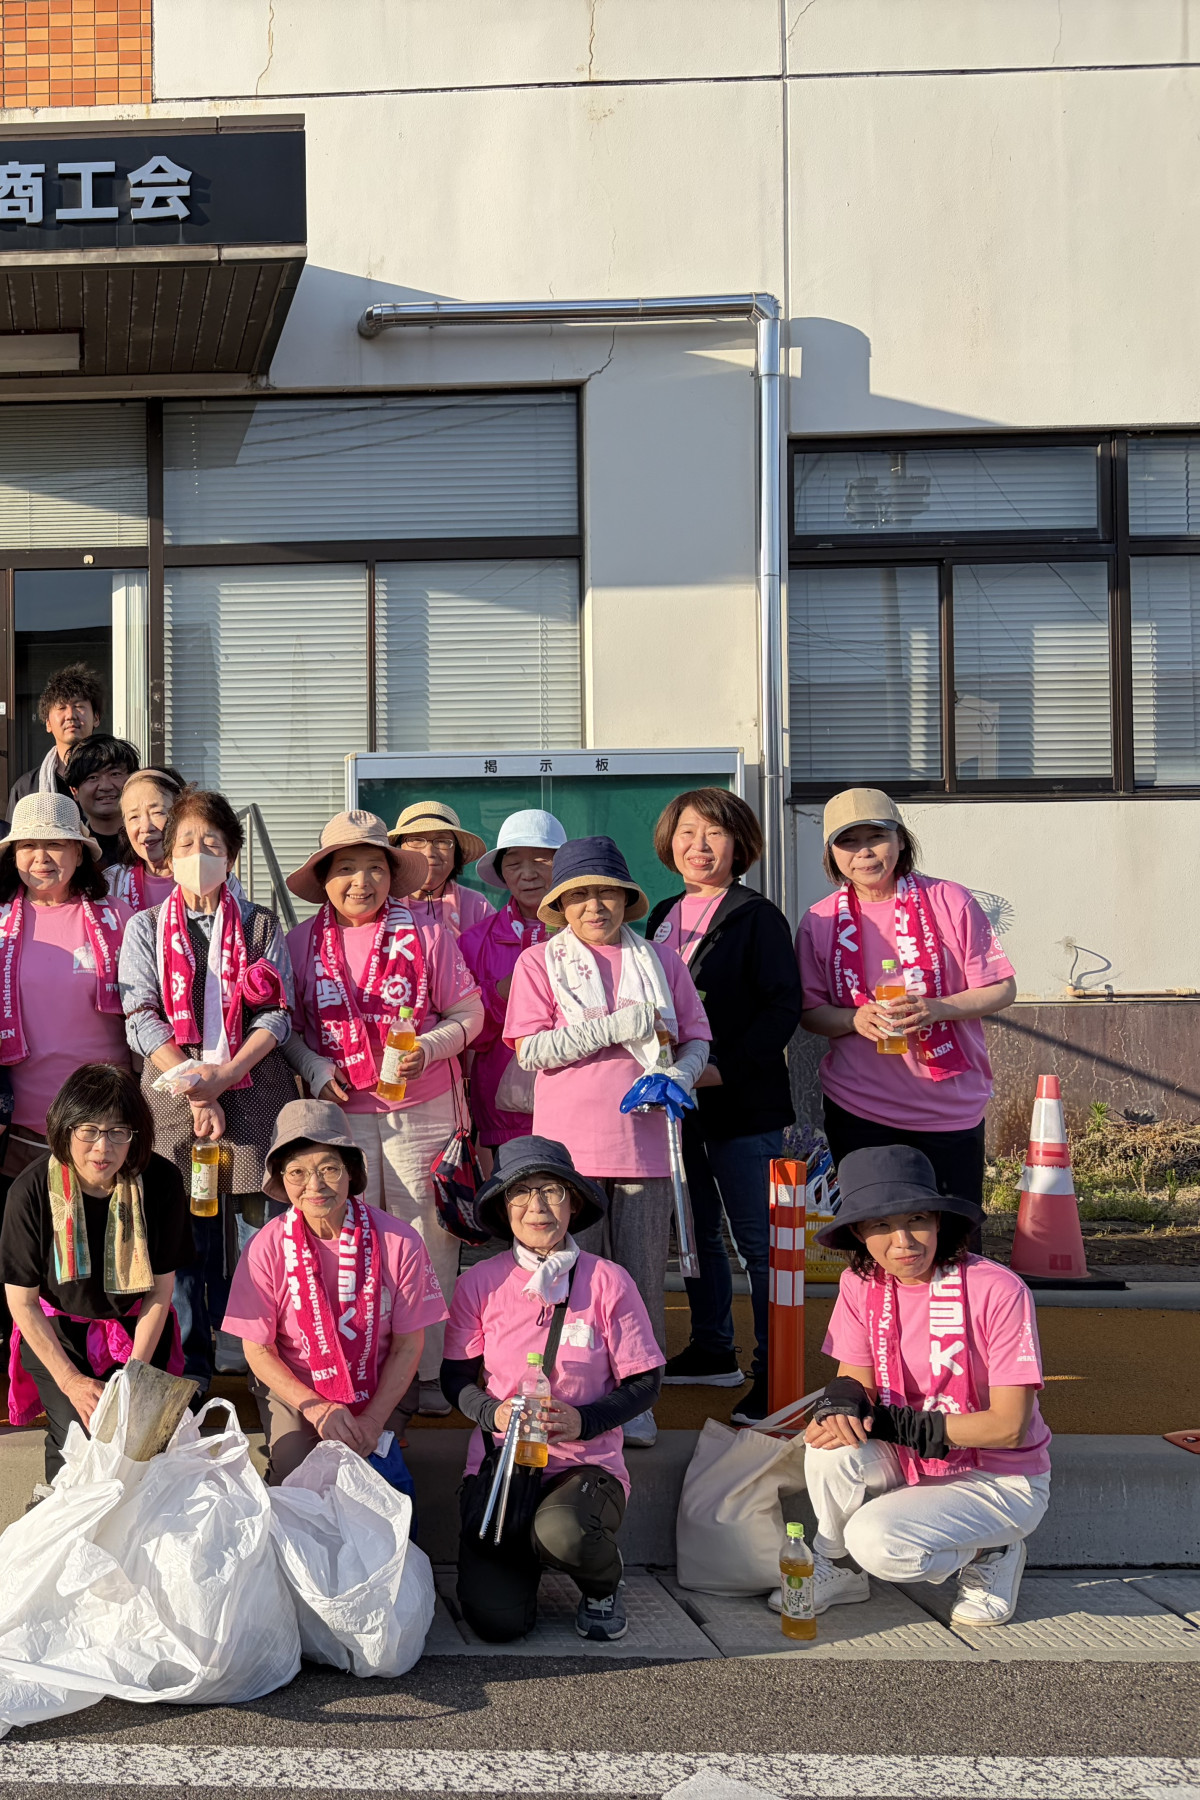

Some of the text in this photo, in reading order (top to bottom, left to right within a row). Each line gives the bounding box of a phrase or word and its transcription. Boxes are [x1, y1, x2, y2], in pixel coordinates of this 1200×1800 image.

[484, 758, 609, 774] 掲示板
[918, 908, 936, 948] Kyowa
[917, 1041, 954, 1060] AISEN
[363, 1247, 375, 1295] Kyowa
[305, 1264, 330, 1355] Nishisenboku
[357, 1301, 374, 1381] Nishisenboku
